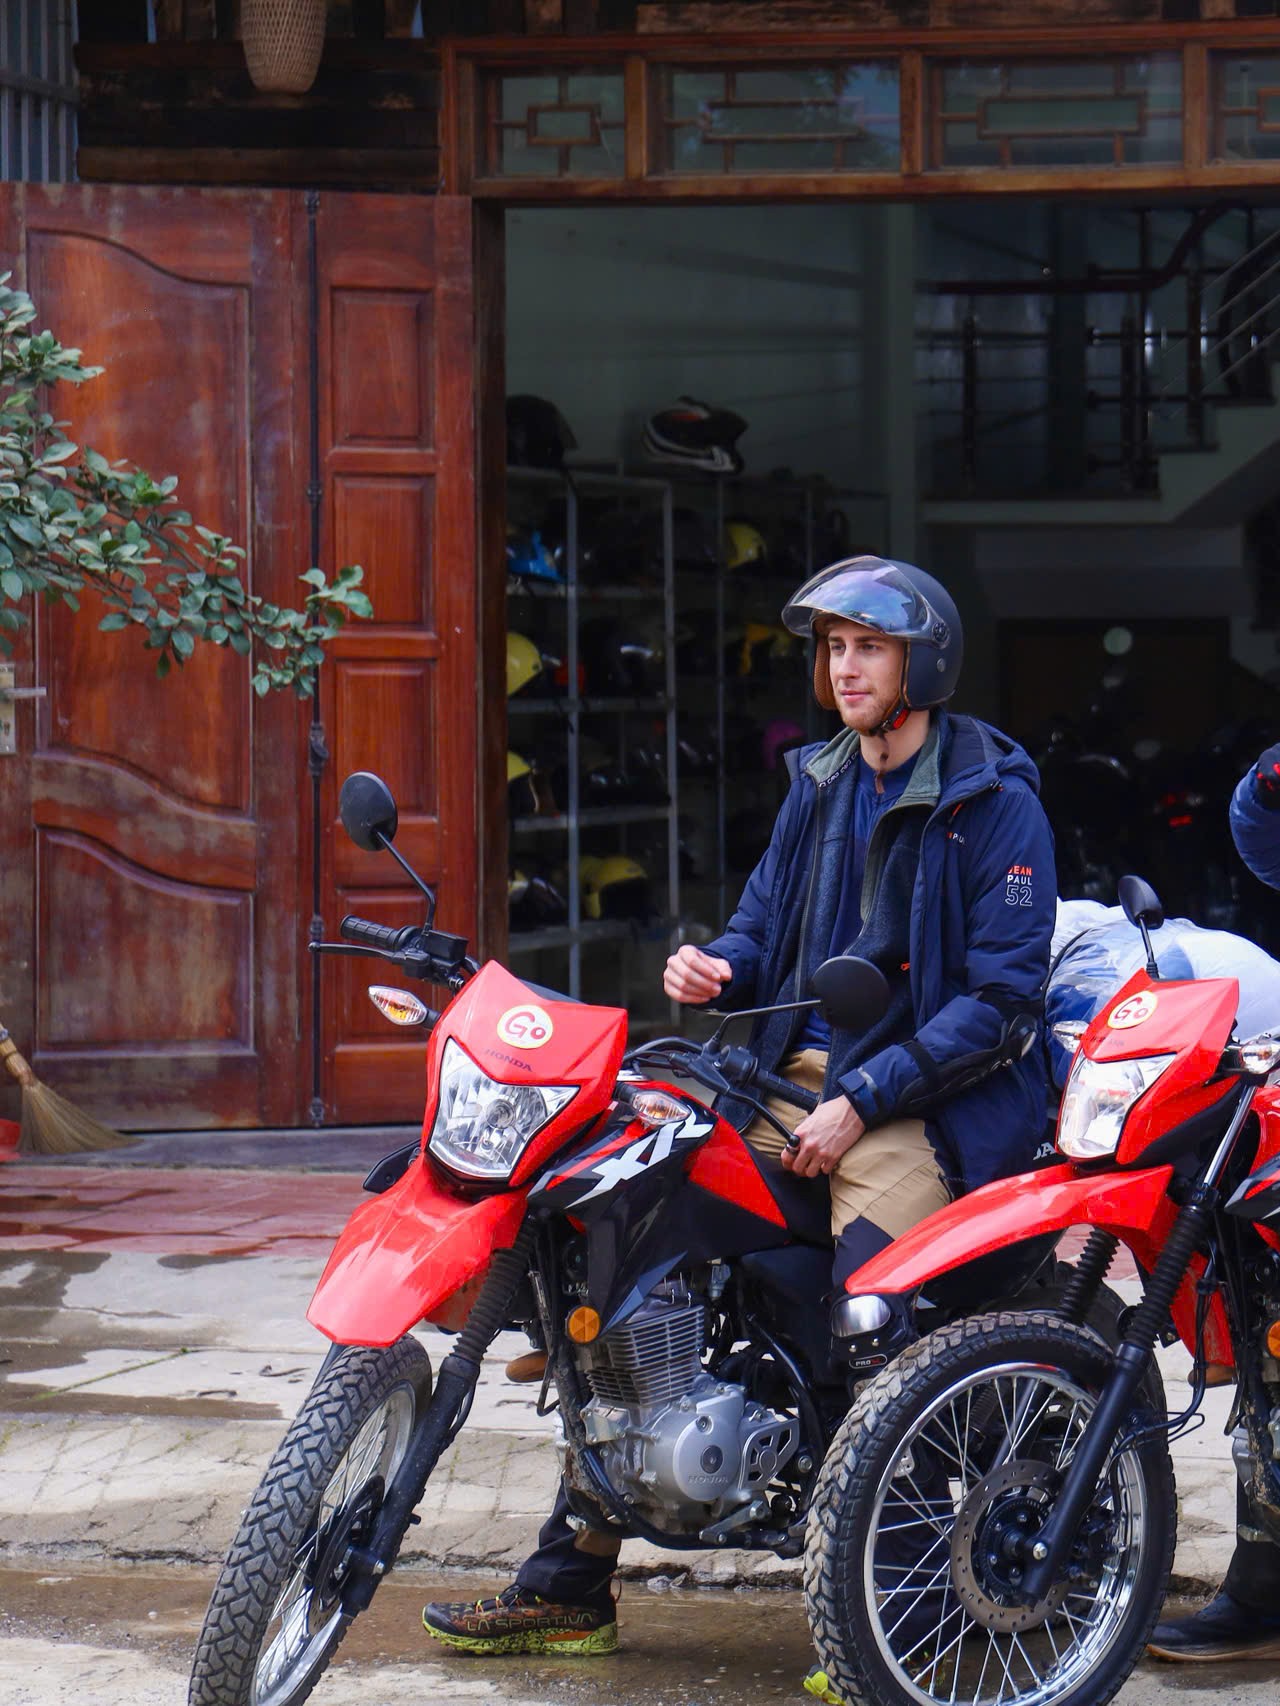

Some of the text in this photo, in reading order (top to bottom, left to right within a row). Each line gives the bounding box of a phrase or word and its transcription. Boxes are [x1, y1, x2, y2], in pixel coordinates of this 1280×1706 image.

[1007, 875, 1032, 885] PAUL
[1008, 865, 1032, 876] JEAN
[1005, 885, 1032, 906] 52
[1115, 996, 1149, 1020] Go
[505, 1011, 546, 1039] Go
[485, 1049, 533, 1072] HONDA
[467, 1613, 593, 1632] LA SPORTIVA
